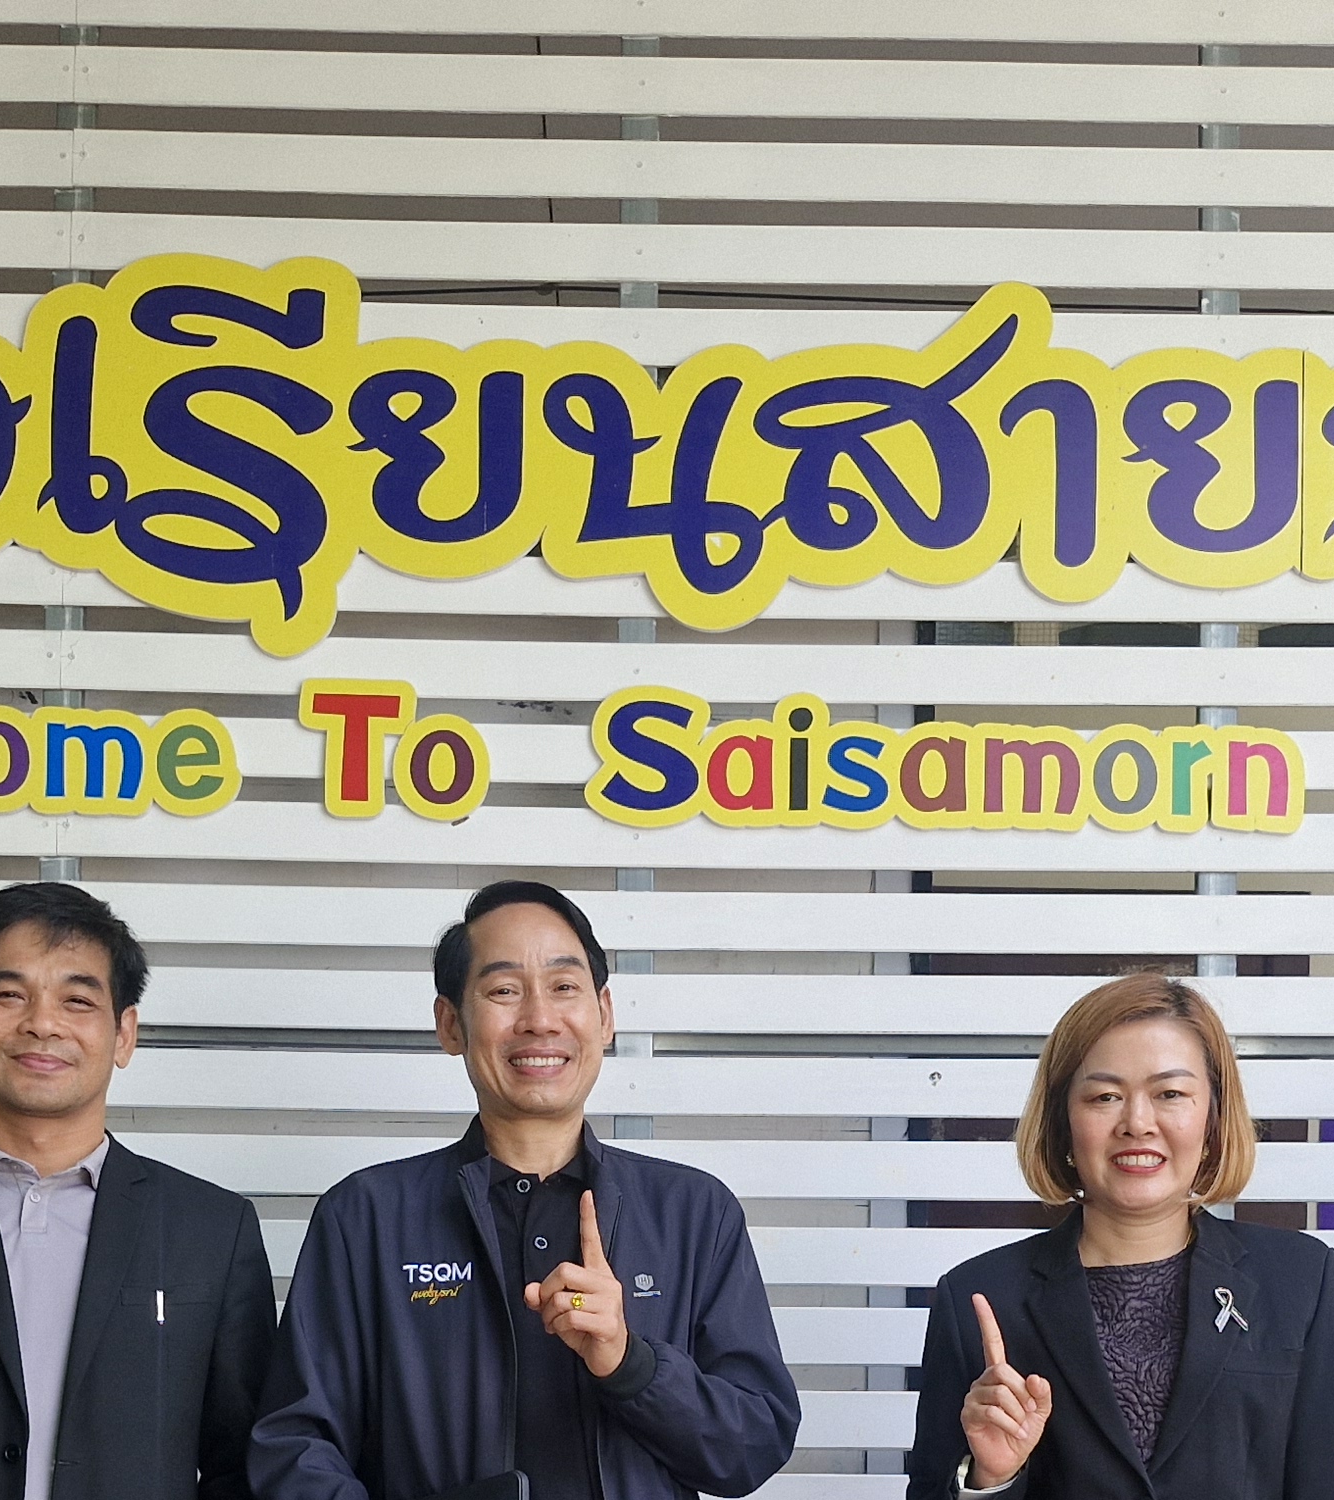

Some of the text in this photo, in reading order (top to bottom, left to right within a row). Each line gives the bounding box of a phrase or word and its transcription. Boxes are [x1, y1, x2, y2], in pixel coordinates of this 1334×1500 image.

[311, 692, 476, 805] To
[599, 699, 1290, 818] Saisamorn
[402, 1261, 472, 1284] TSQM
